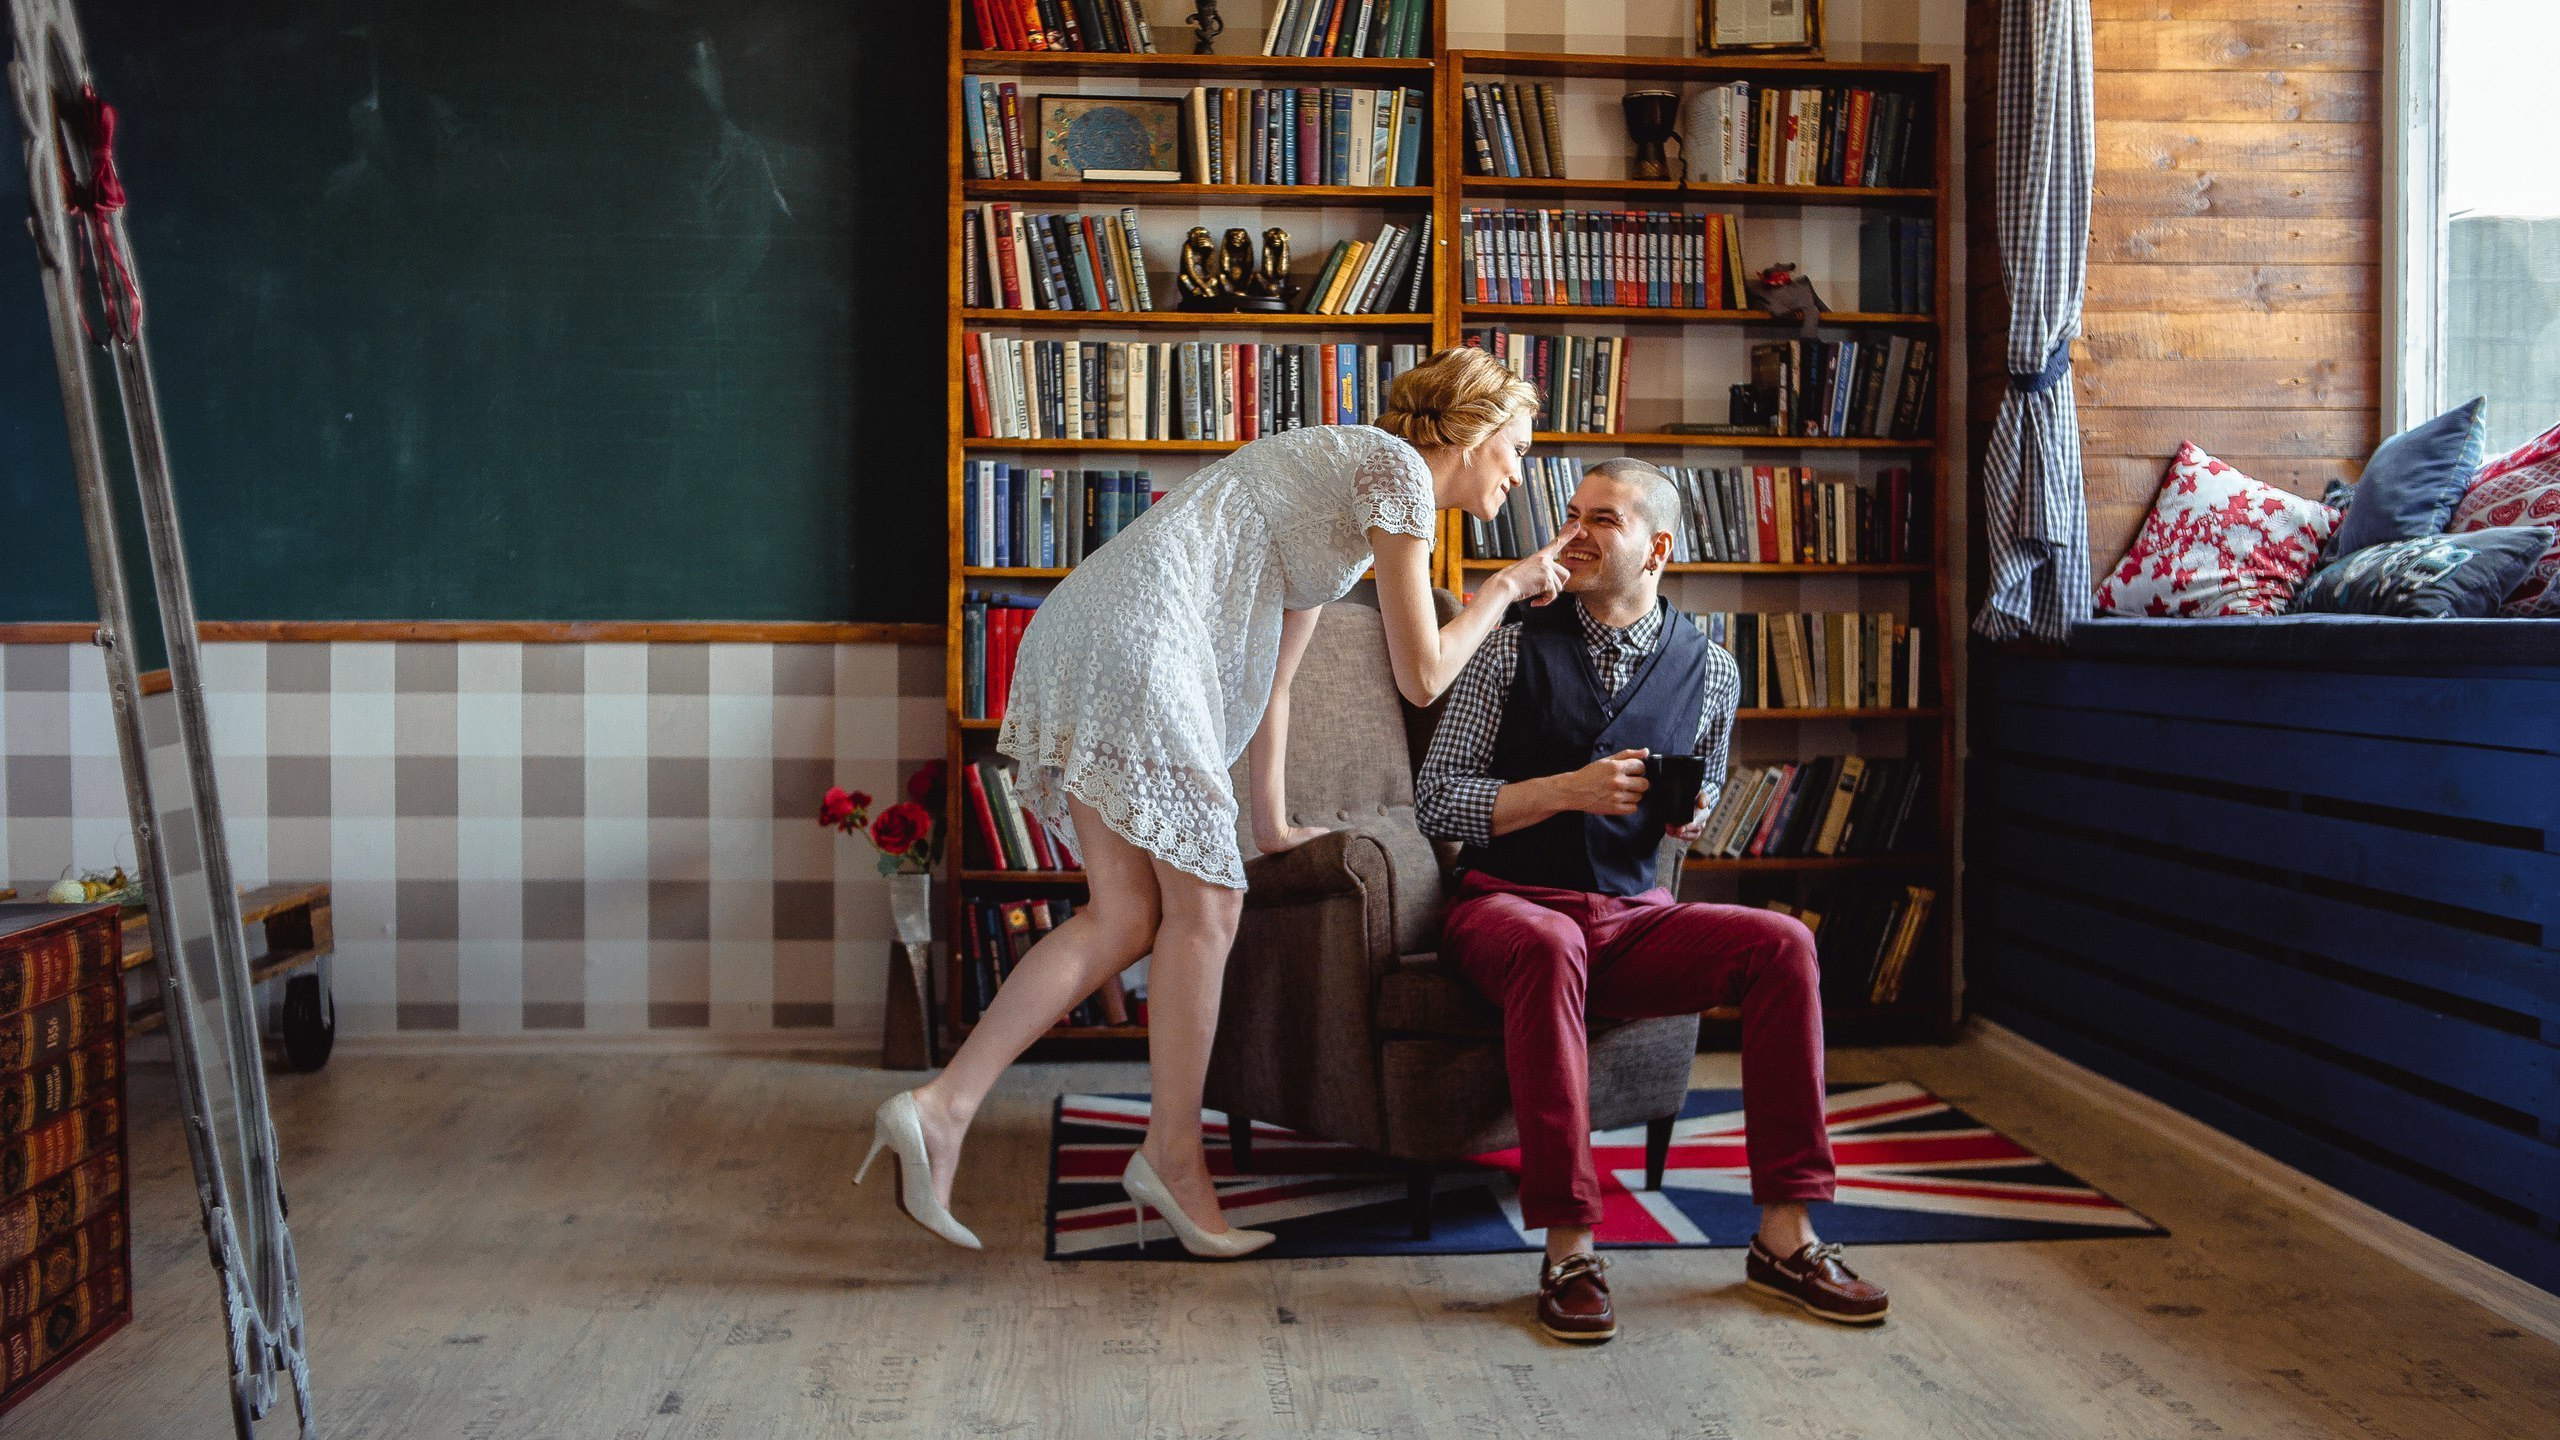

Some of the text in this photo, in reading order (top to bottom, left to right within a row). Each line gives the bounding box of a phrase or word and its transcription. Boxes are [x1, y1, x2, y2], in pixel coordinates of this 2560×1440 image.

[1285, 96, 1295, 181] БОРИС ПАСТЕРНАК
[1289, 354, 1298, 390] РЕМАРК
[1042, 522, 1050, 560] ЭТИКЕТ
